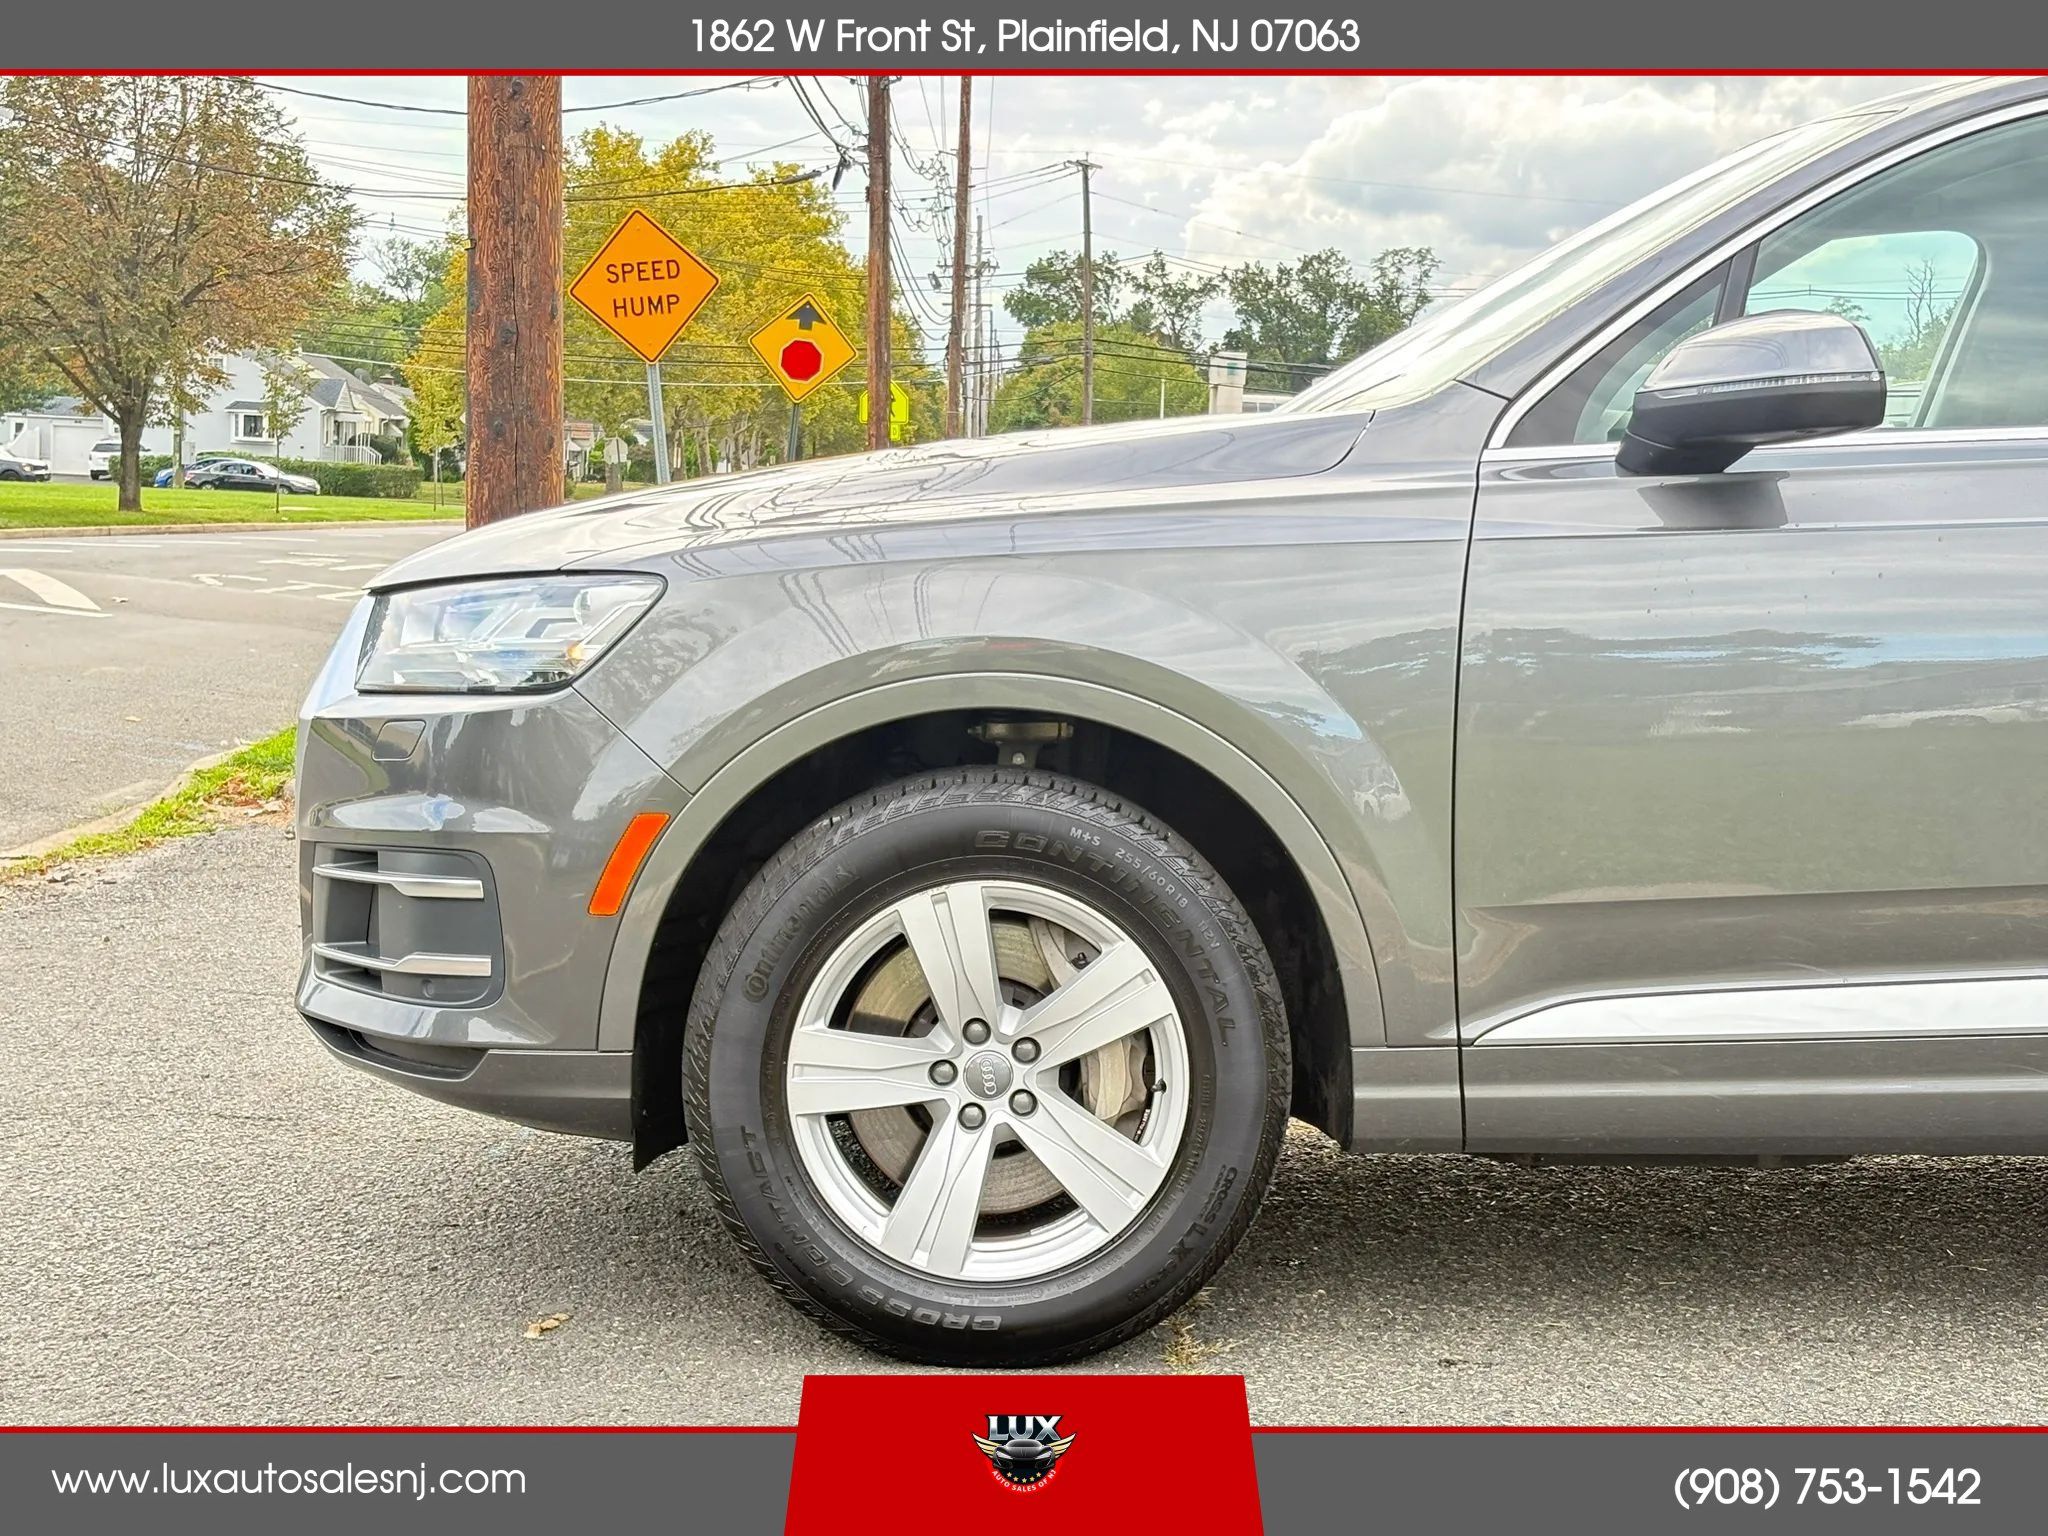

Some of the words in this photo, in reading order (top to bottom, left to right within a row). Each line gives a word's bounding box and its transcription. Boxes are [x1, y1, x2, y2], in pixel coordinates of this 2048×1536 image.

[606, 259, 680, 284] SPEED
[613, 294, 680, 318] HUMP
[1069, 826, 1101, 847] M+S
[740, 1124, 854, 1287] CONTACT
[856, 1284, 1001, 1331] CROSS
